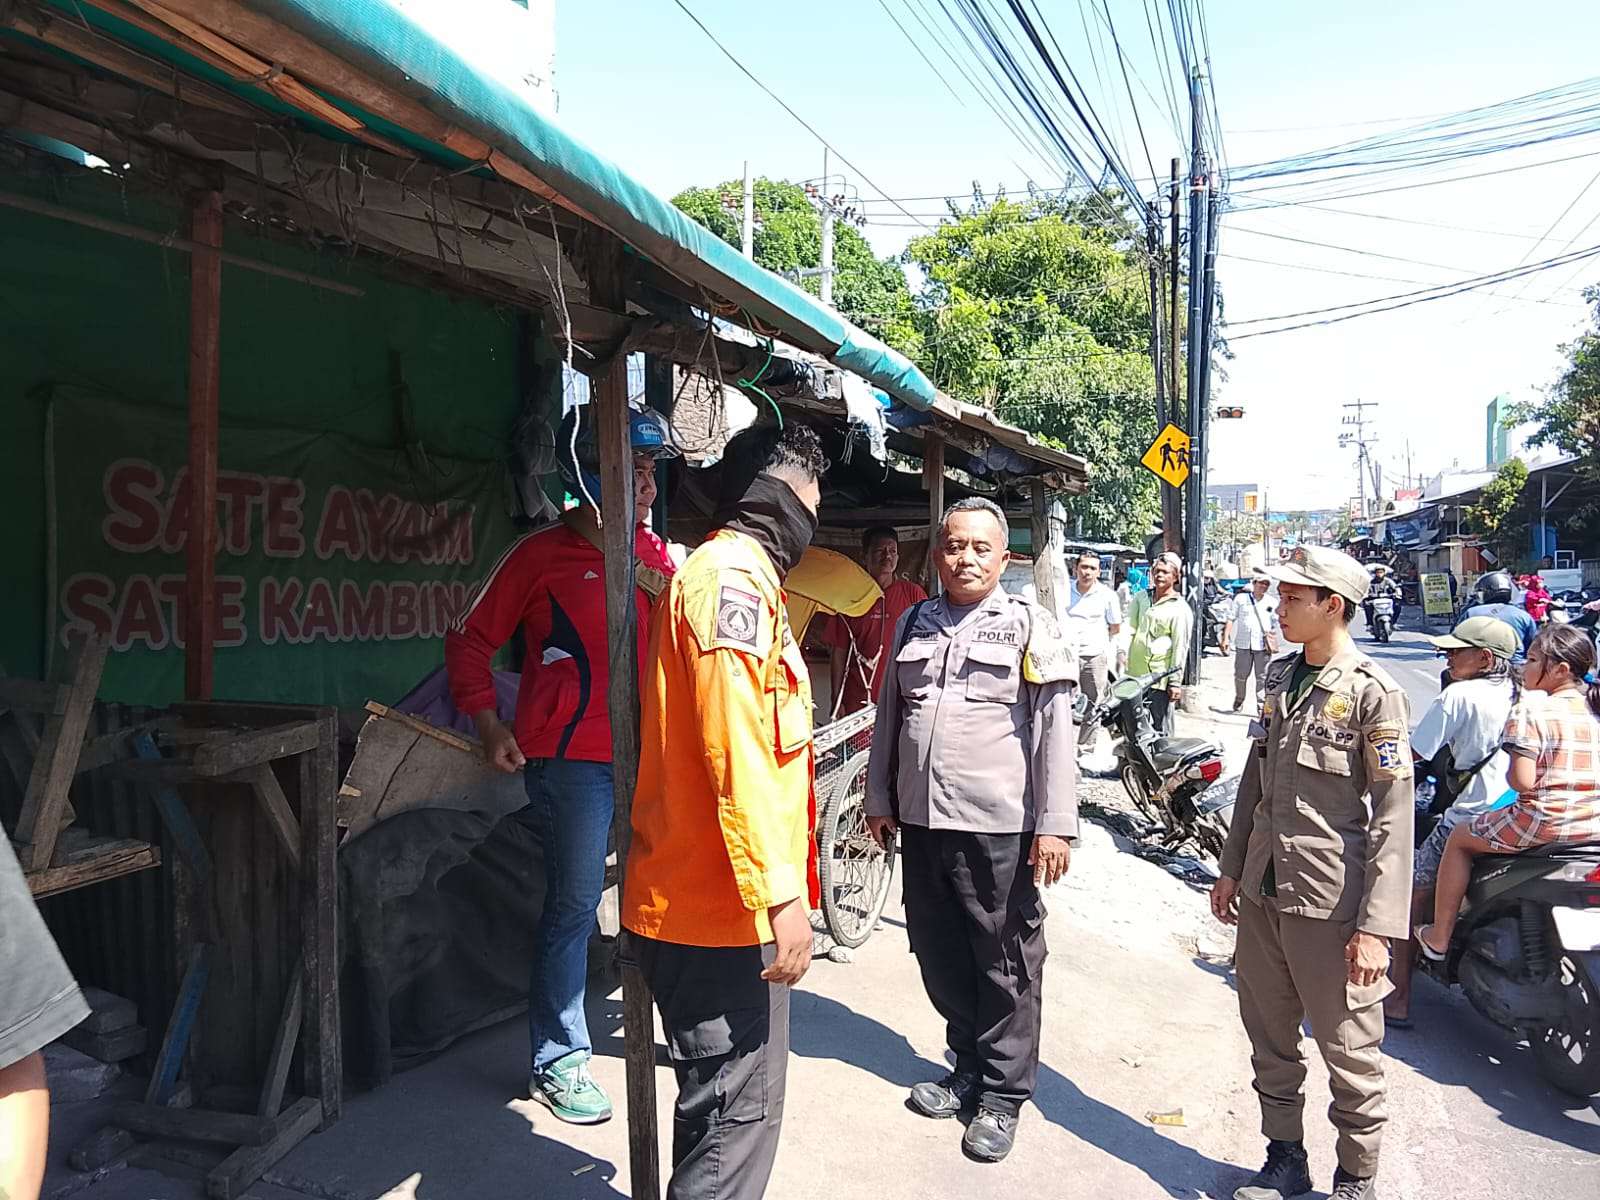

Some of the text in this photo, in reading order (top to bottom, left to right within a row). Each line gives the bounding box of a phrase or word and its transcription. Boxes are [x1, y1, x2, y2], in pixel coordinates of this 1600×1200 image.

[103, 459, 475, 565] SATE AYAM
[61, 574, 480, 651] SATE KAMBIN
[977, 631, 1016, 643] POLRI
[1306, 722, 1333, 740] POL
[1335, 732, 1354, 744] PP
